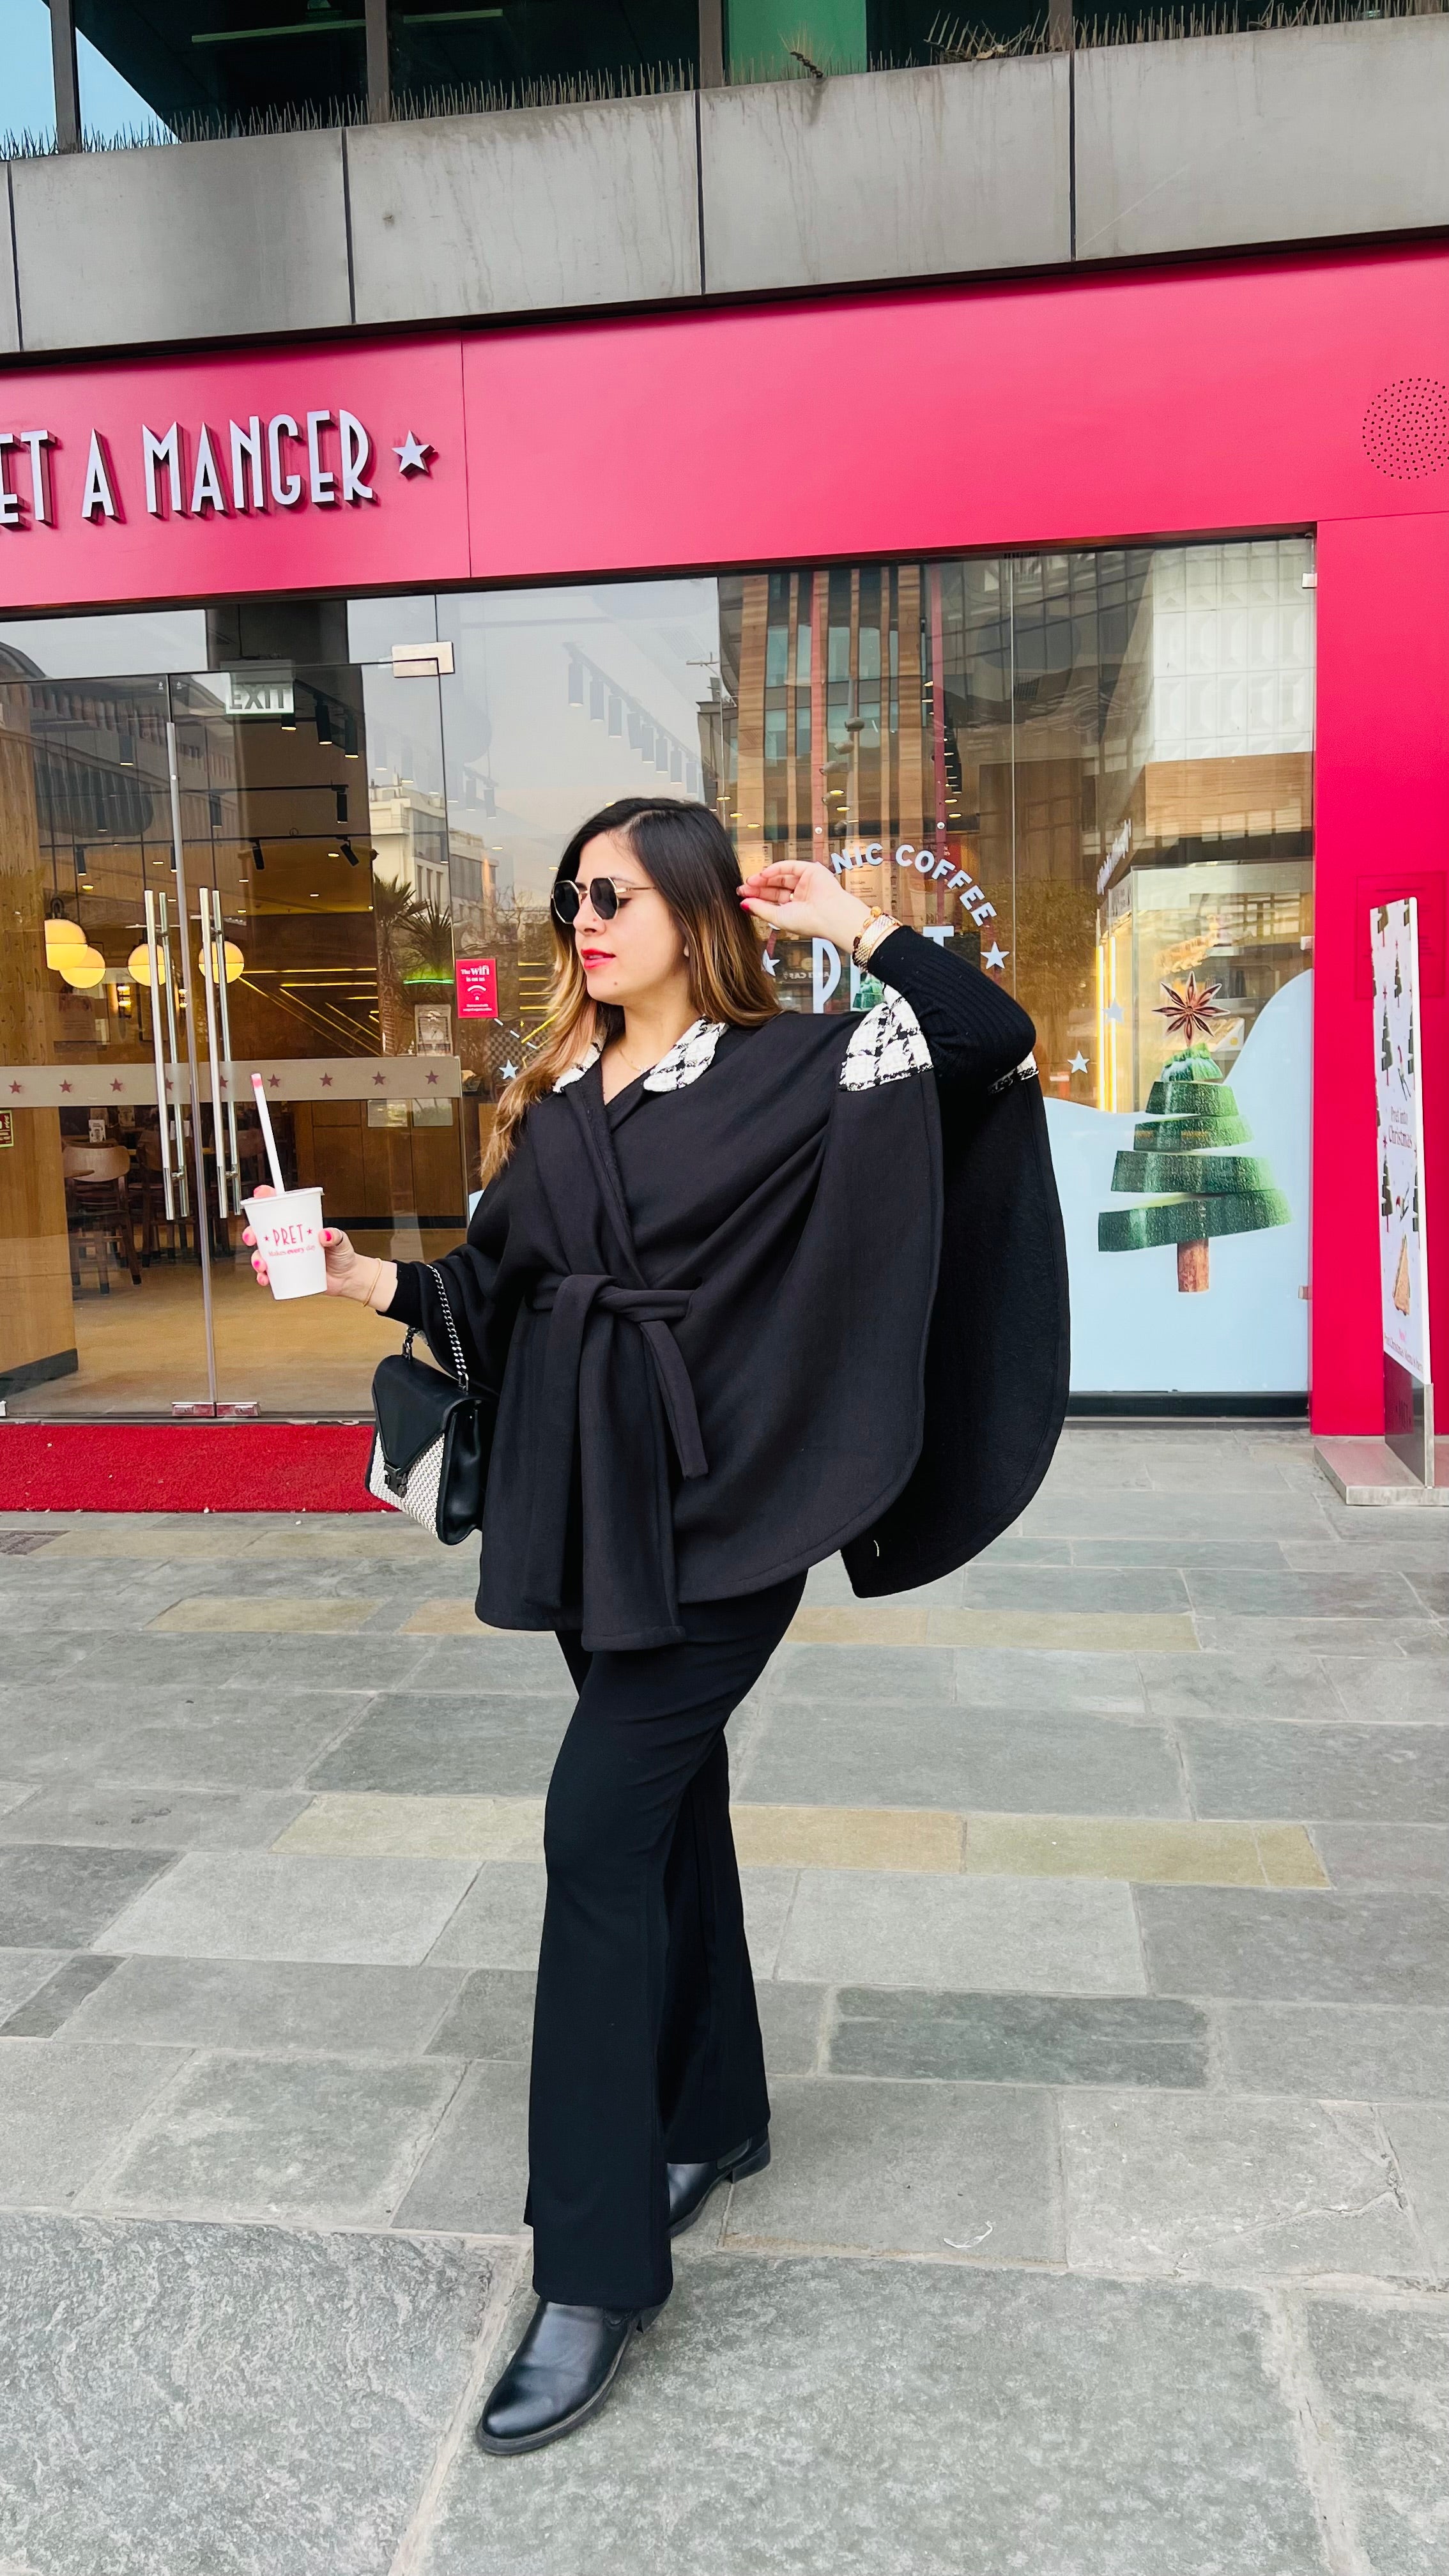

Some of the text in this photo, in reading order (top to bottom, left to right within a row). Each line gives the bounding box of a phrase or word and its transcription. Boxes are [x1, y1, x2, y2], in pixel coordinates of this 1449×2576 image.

[82, 428, 116, 519] A
[142, 409, 374, 514] MANGER
[229, 685, 287, 710] EXIT
[895, 844, 997, 926] COFFEE
[272, 1224, 303, 1246] PRET
